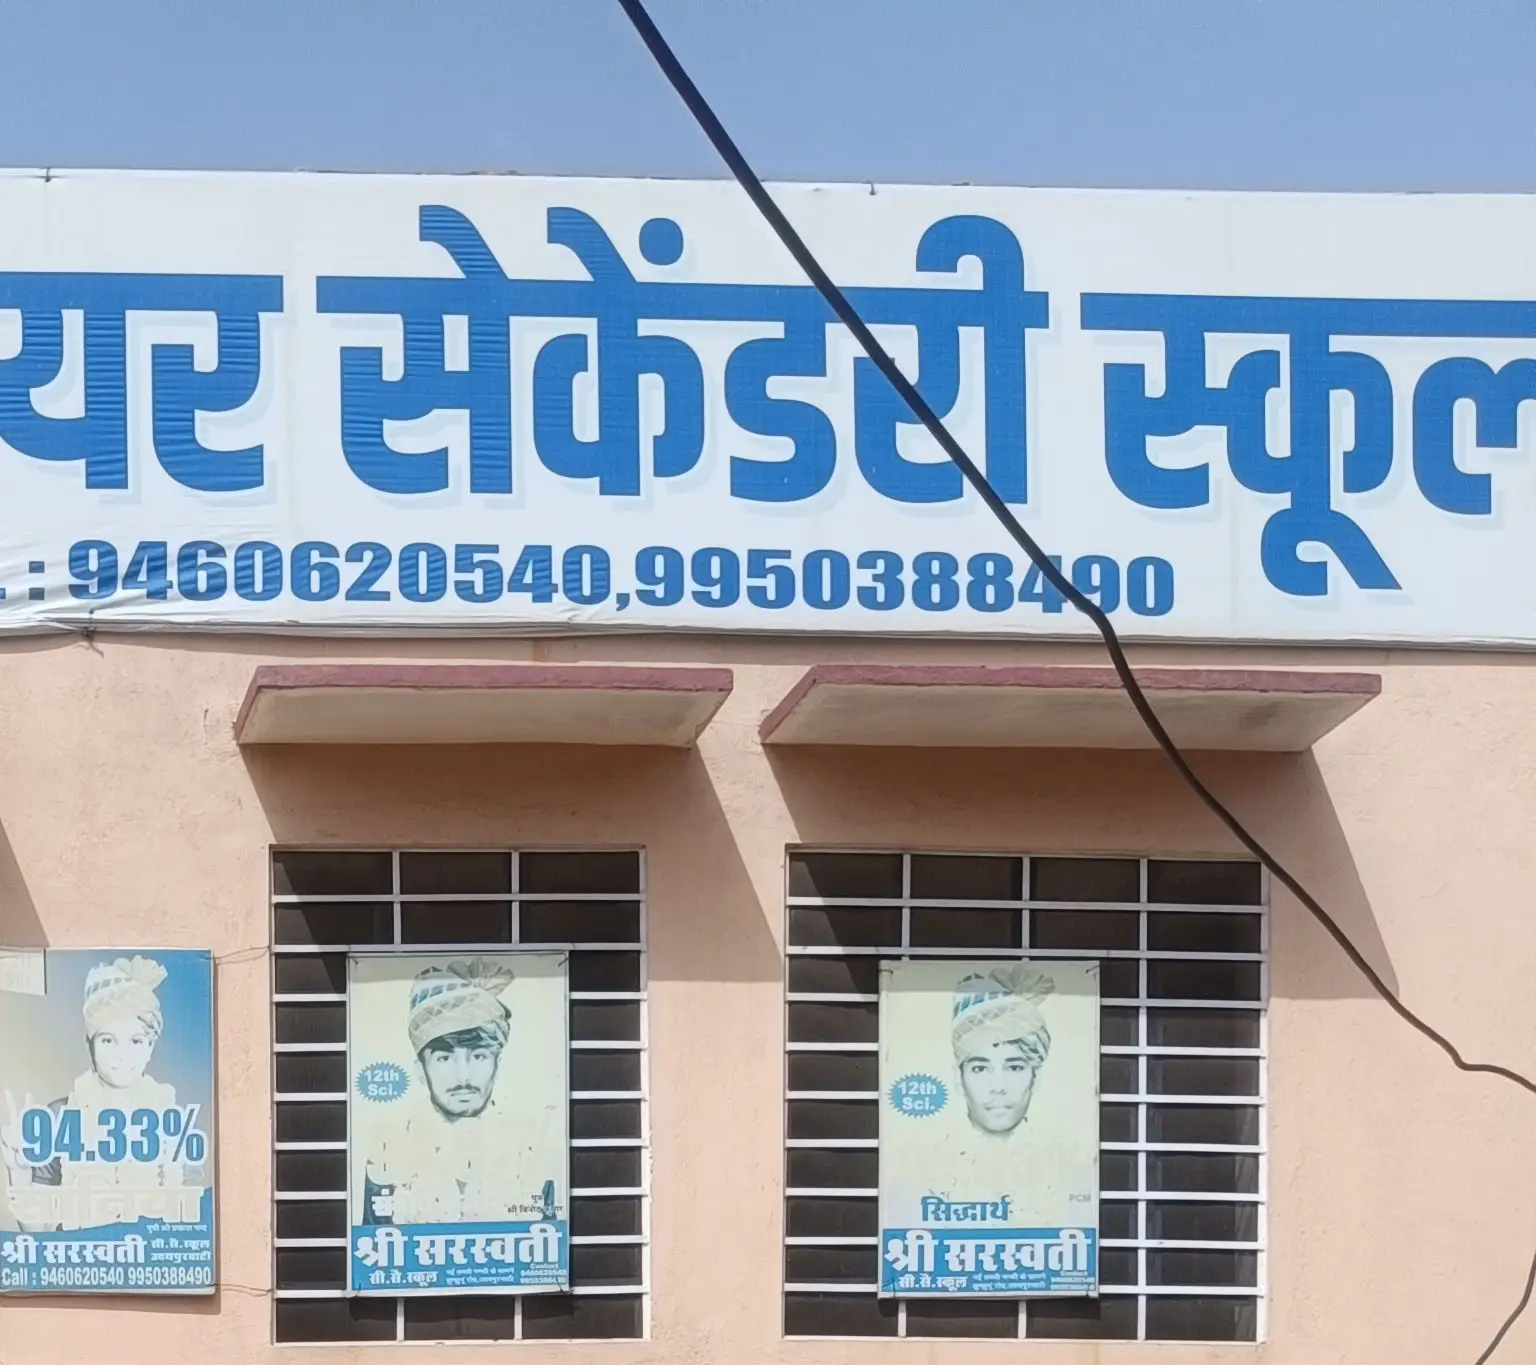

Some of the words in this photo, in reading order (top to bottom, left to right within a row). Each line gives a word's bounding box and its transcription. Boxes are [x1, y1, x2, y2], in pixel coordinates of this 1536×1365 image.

[316, 204, 1049, 504] सेकेंडरी
[365, 1070, 400, 1082] 12th
[898, 1081, 937, 1095] 12th
[367, 1083, 398, 1096] Sci.
[902, 1096, 936, 1110] Sci.
[21, 1107, 205, 1164] 94.33%
[1, 1235, 39, 1264] श्री
[41, 1234, 147, 1264] सरस्वती
[354, 1227, 408, 1267] श्री
[413, 1223, 562, 1266] सरस्वती
[884, 1229, 938, 1272] श्री
[943, 1228, 1092, 1272] सरस्वती
[1, 1267, 28, 1286] Call
[40, 1267, 125, 1286] 9460620540
[127, 1266, 212, 1286] 9950388490
